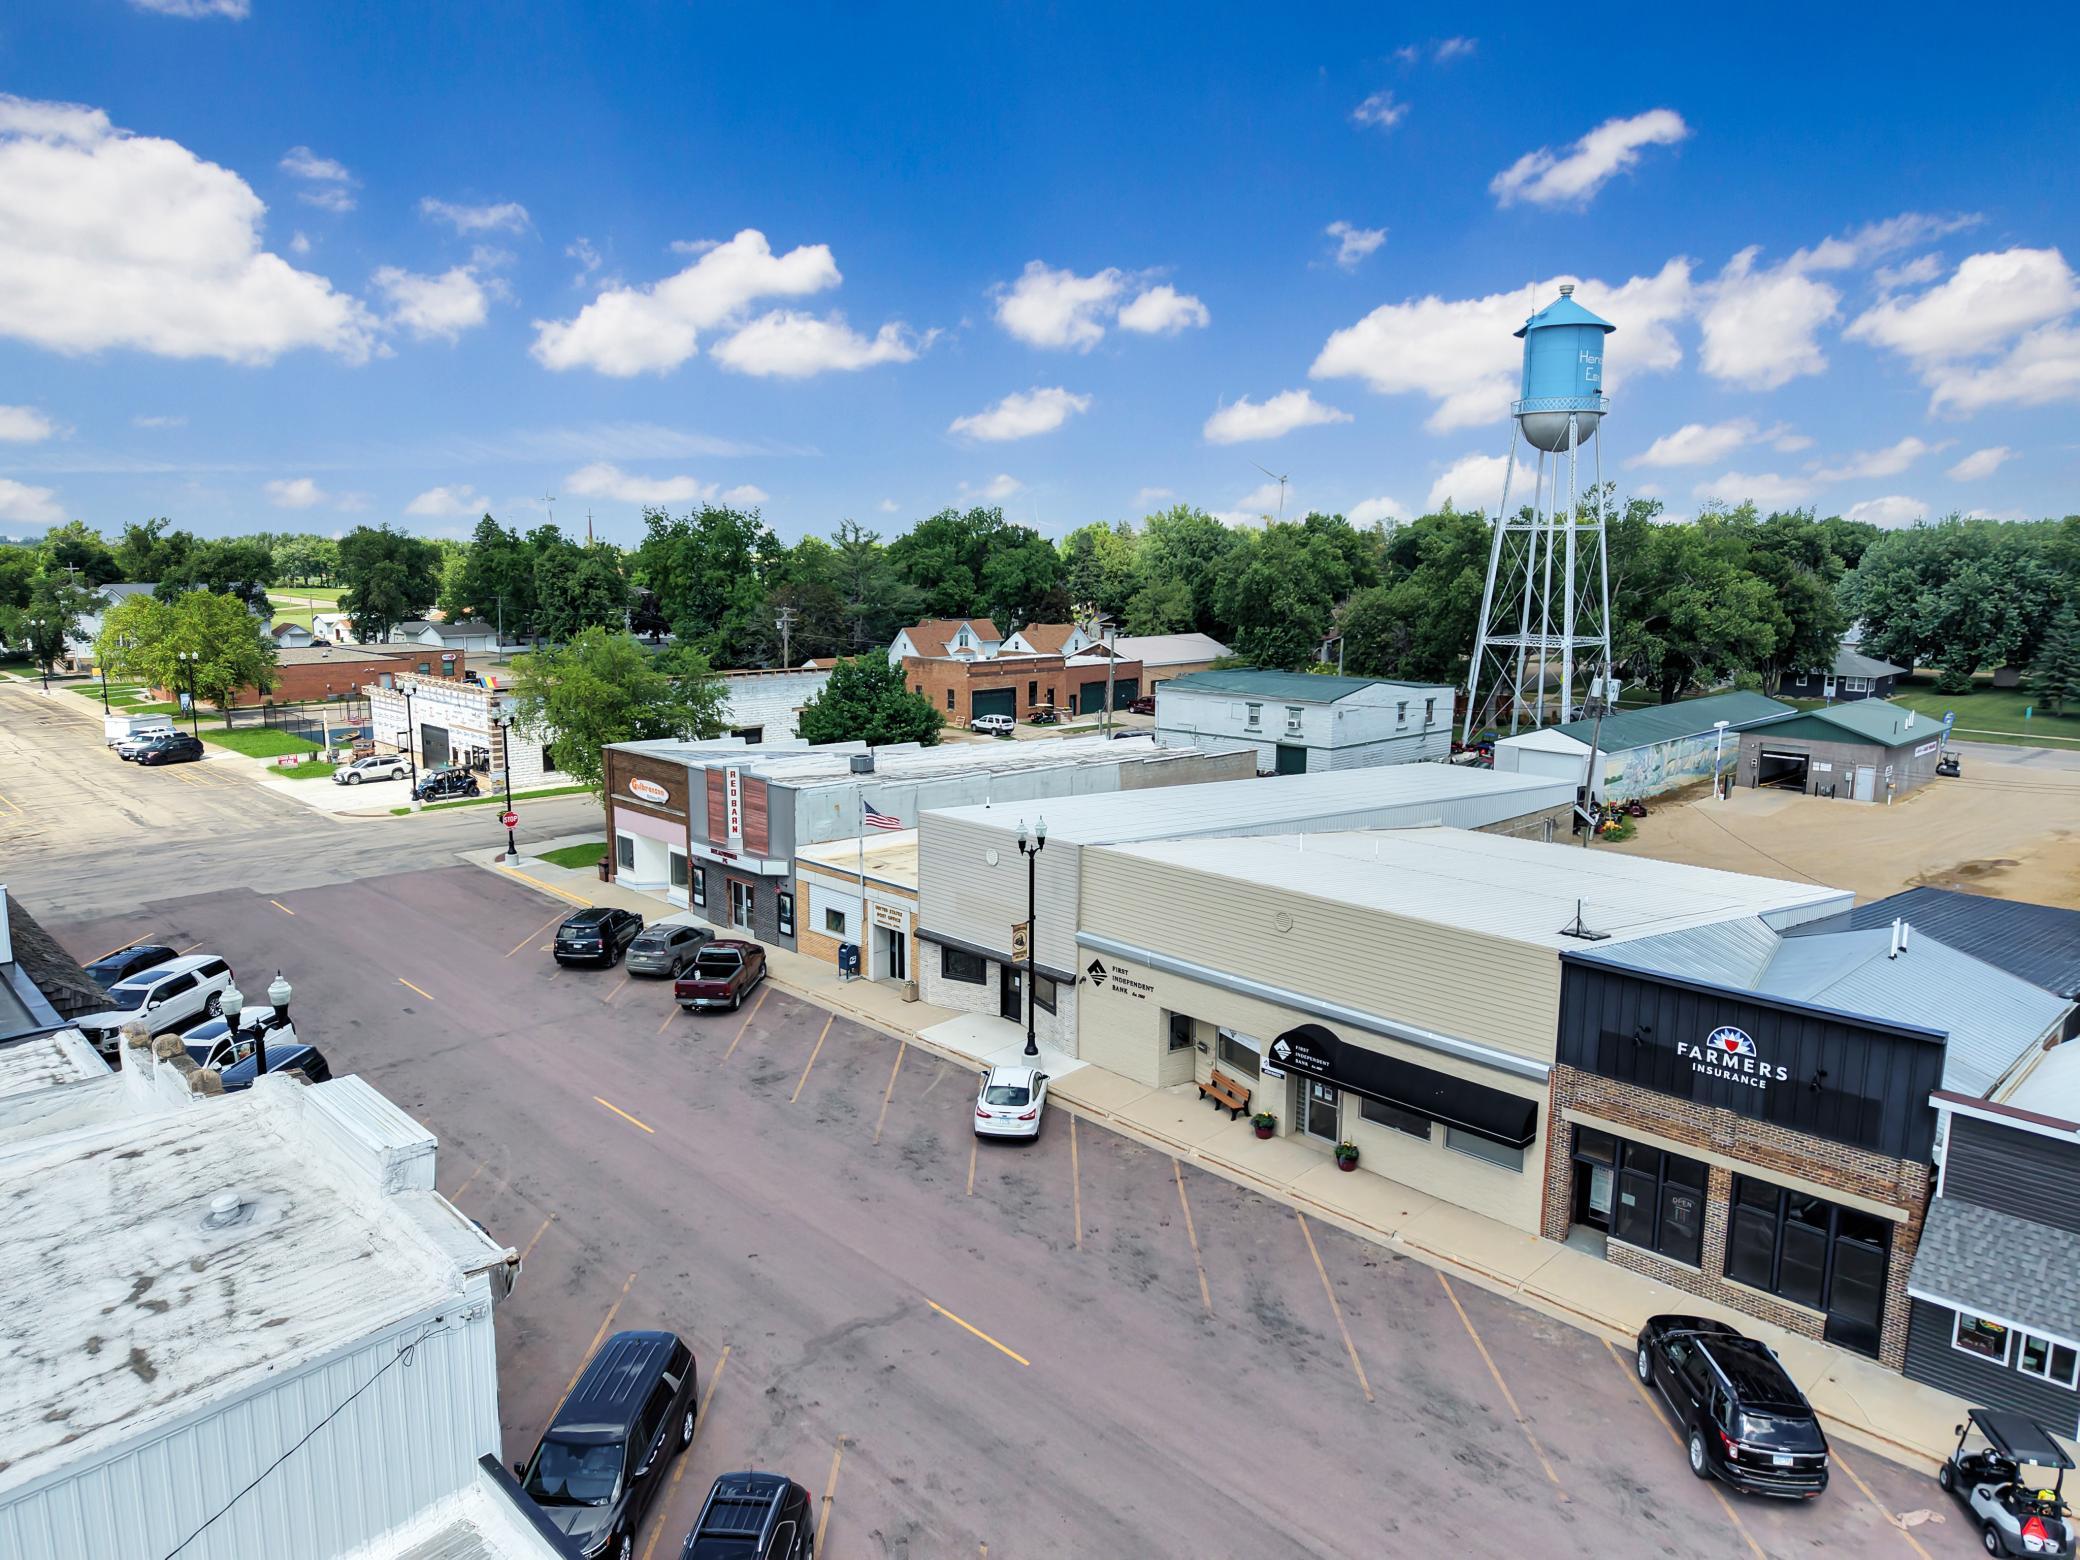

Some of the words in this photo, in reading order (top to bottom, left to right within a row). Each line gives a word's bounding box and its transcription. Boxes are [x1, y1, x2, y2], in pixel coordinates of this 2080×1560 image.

[729, 770, 737, 796] RED
[503, 815, 518, 823] STOP
[1112, 966, 1128, 975] FIRST
[1112, 976, 1155, 993] INDEPENDENT
[1112, 985, 1128, 994] BANK
[1295, 1045, 1310, 1053] FIRST
[1295, 1052, 1330, 1067] INDEPENDENT
[1295, 1059, 1309, 1067] BANK
[1677, 1041, 1788, 1080] FARMERS
[1692, 1062, 1767, 1089] INSURANCE
[1672, 1196, 1692, 1208] OPEN
